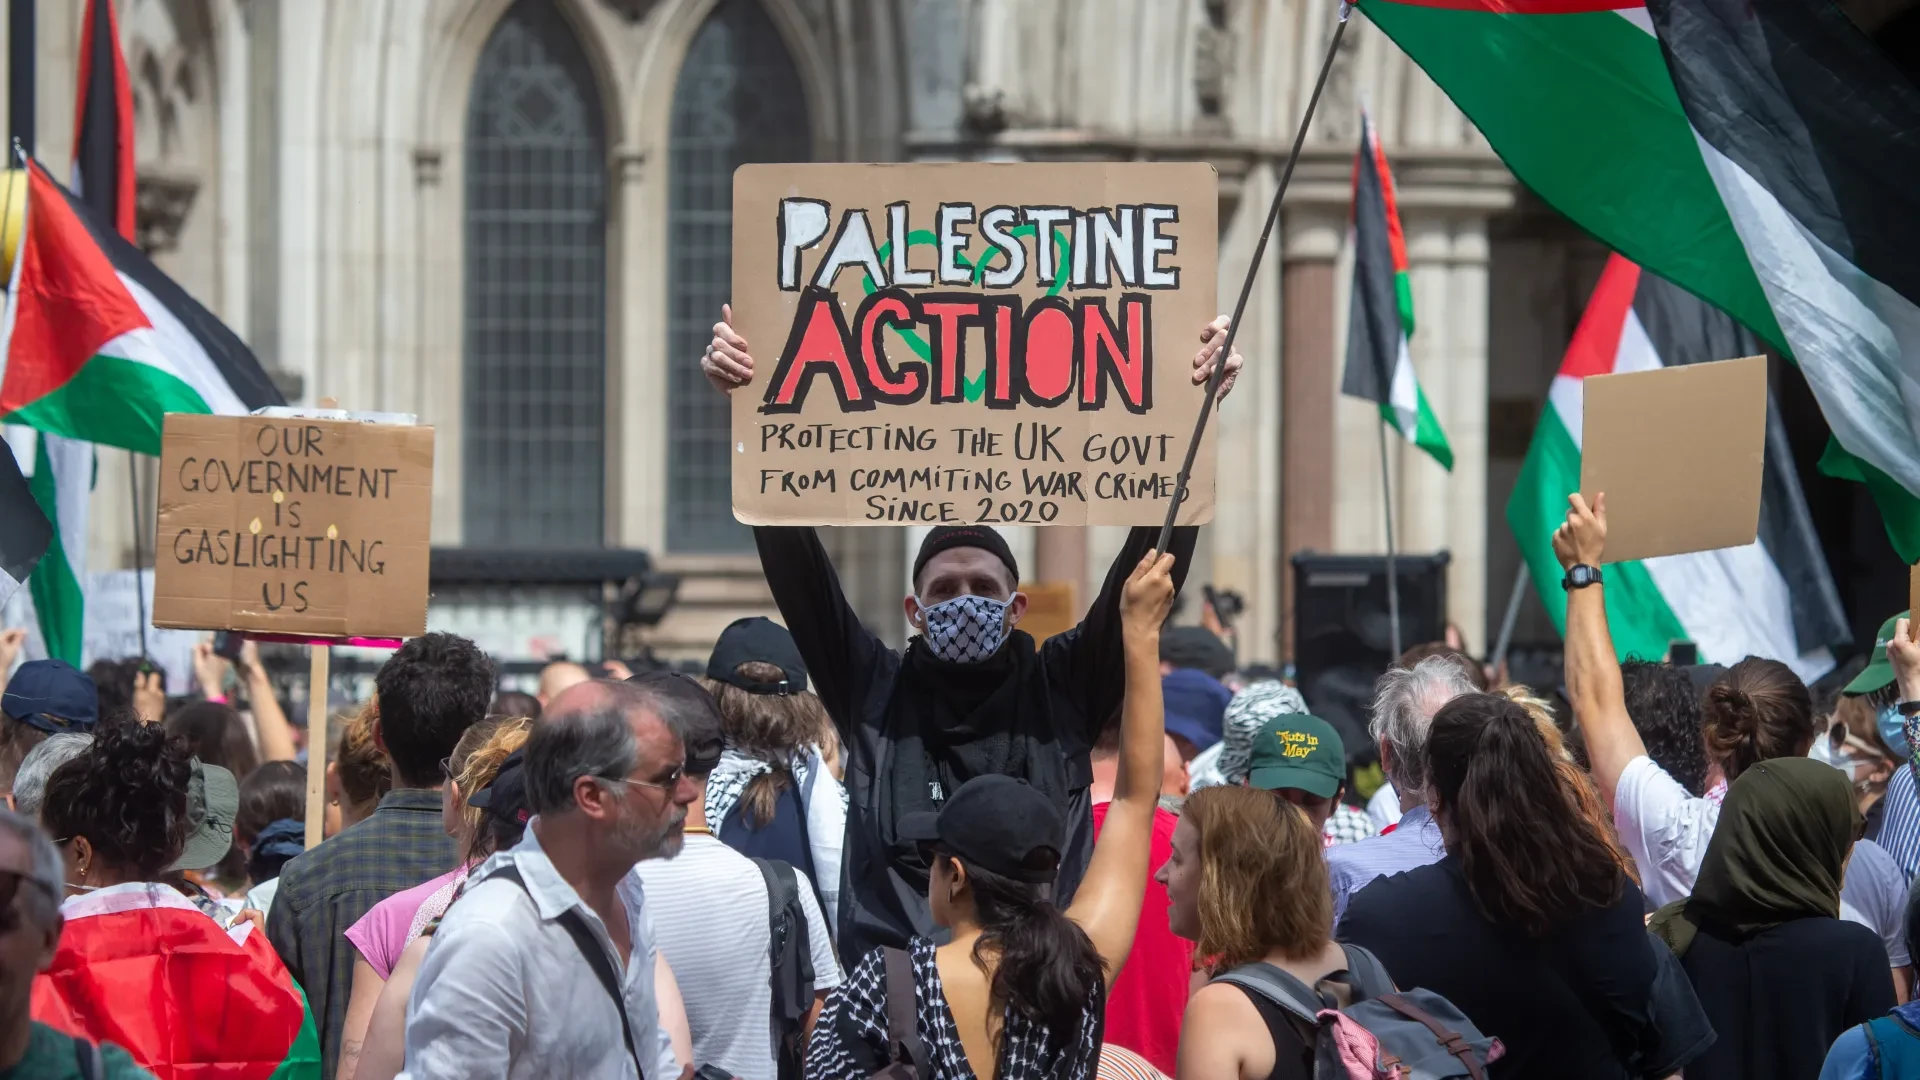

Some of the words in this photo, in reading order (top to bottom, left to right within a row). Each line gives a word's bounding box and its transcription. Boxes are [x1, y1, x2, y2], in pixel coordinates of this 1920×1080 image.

[777, 197, 1180, 292] PALESTINE
[757, 287, 1153, 415] ACTION
[257, 424, 323, 457] OUR
[760, 423, 938, 453] PROTECTING
[950, 427, 1003, 457] THE
[1014, 422, 1065, 463] UK
[1082, 434, 1175, 465] GOVT
[178, 457, 398, 499] GOVERNMENT
[760, 468, 837, 497] FROM
[850, 465, 1012, 493] COMMITING
[1022, 468, 1087, 502] WAR
[274, 501, 301, 529] IS
[865, 494, 960, 522] SINCE
[975, 498, 1059, 523] 2020
[173, 528, 385, 576] GASLIGHTING
[262, 581, 309, 612] US
[1307, 733, 1318, 745] in
